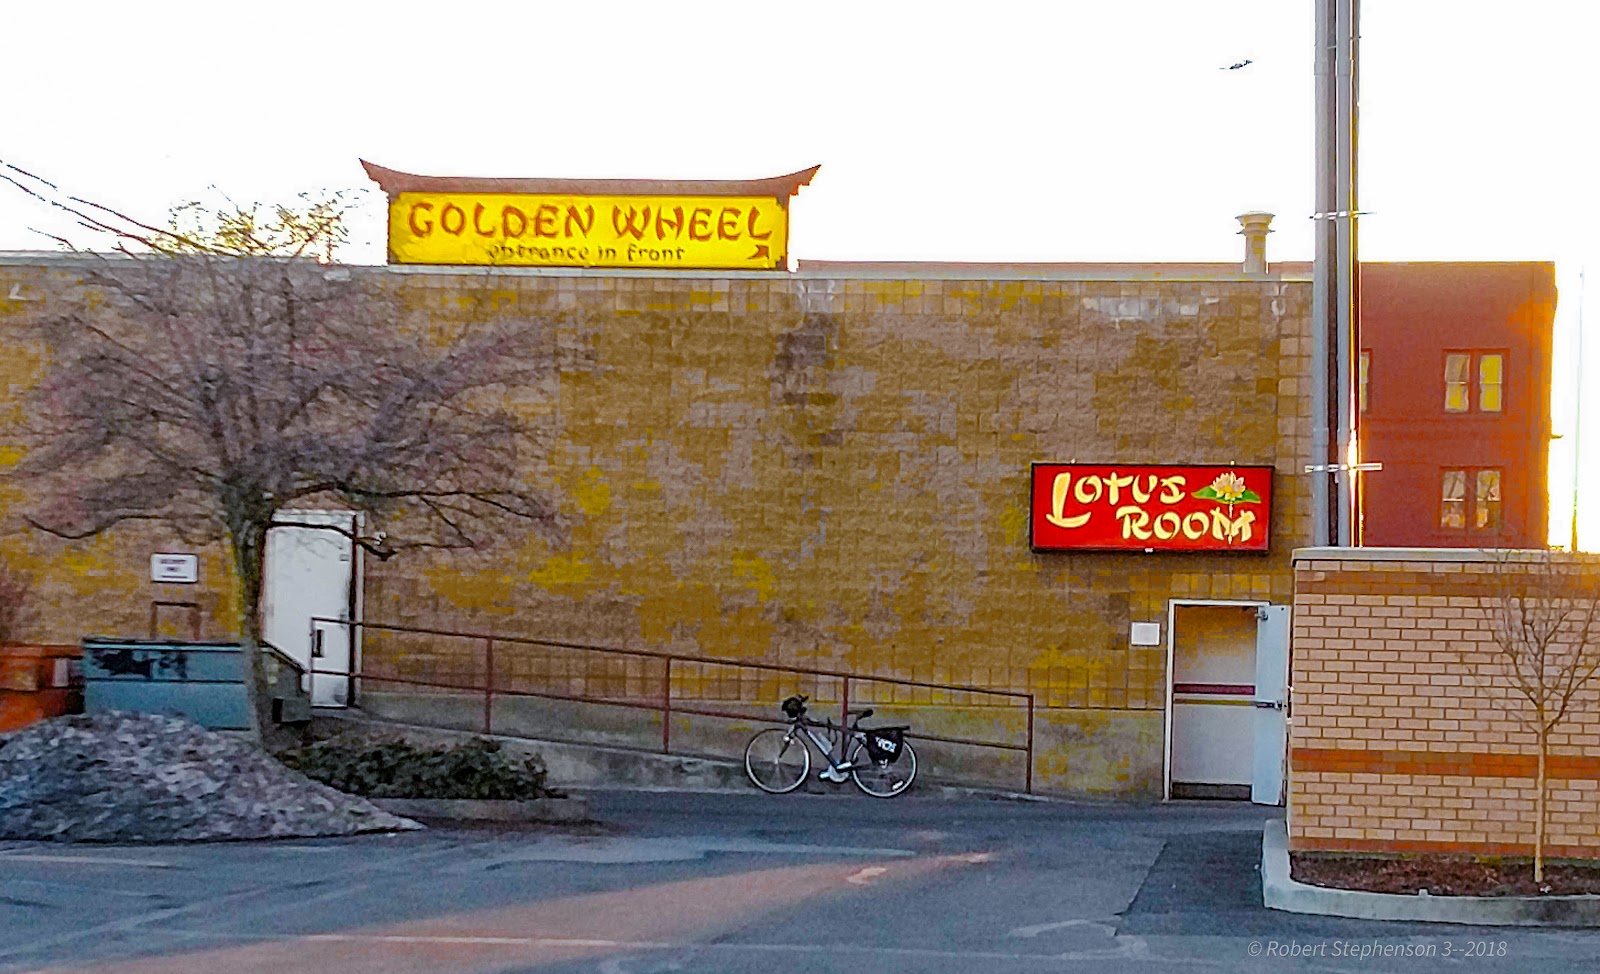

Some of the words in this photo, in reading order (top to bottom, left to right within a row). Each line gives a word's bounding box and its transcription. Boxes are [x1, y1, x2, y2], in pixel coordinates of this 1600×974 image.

[407, 201, 596, 239] GOLDEN
[611, 203, 773, 242] WHEEL
[486, 244, 590, 261] entrance
[598, 244, 617, 260] in
[627, 242, 685, 262] front
[1045, 471, 1187, 528] LOTUS
[1115, 505, 1256, 542] ROOM
